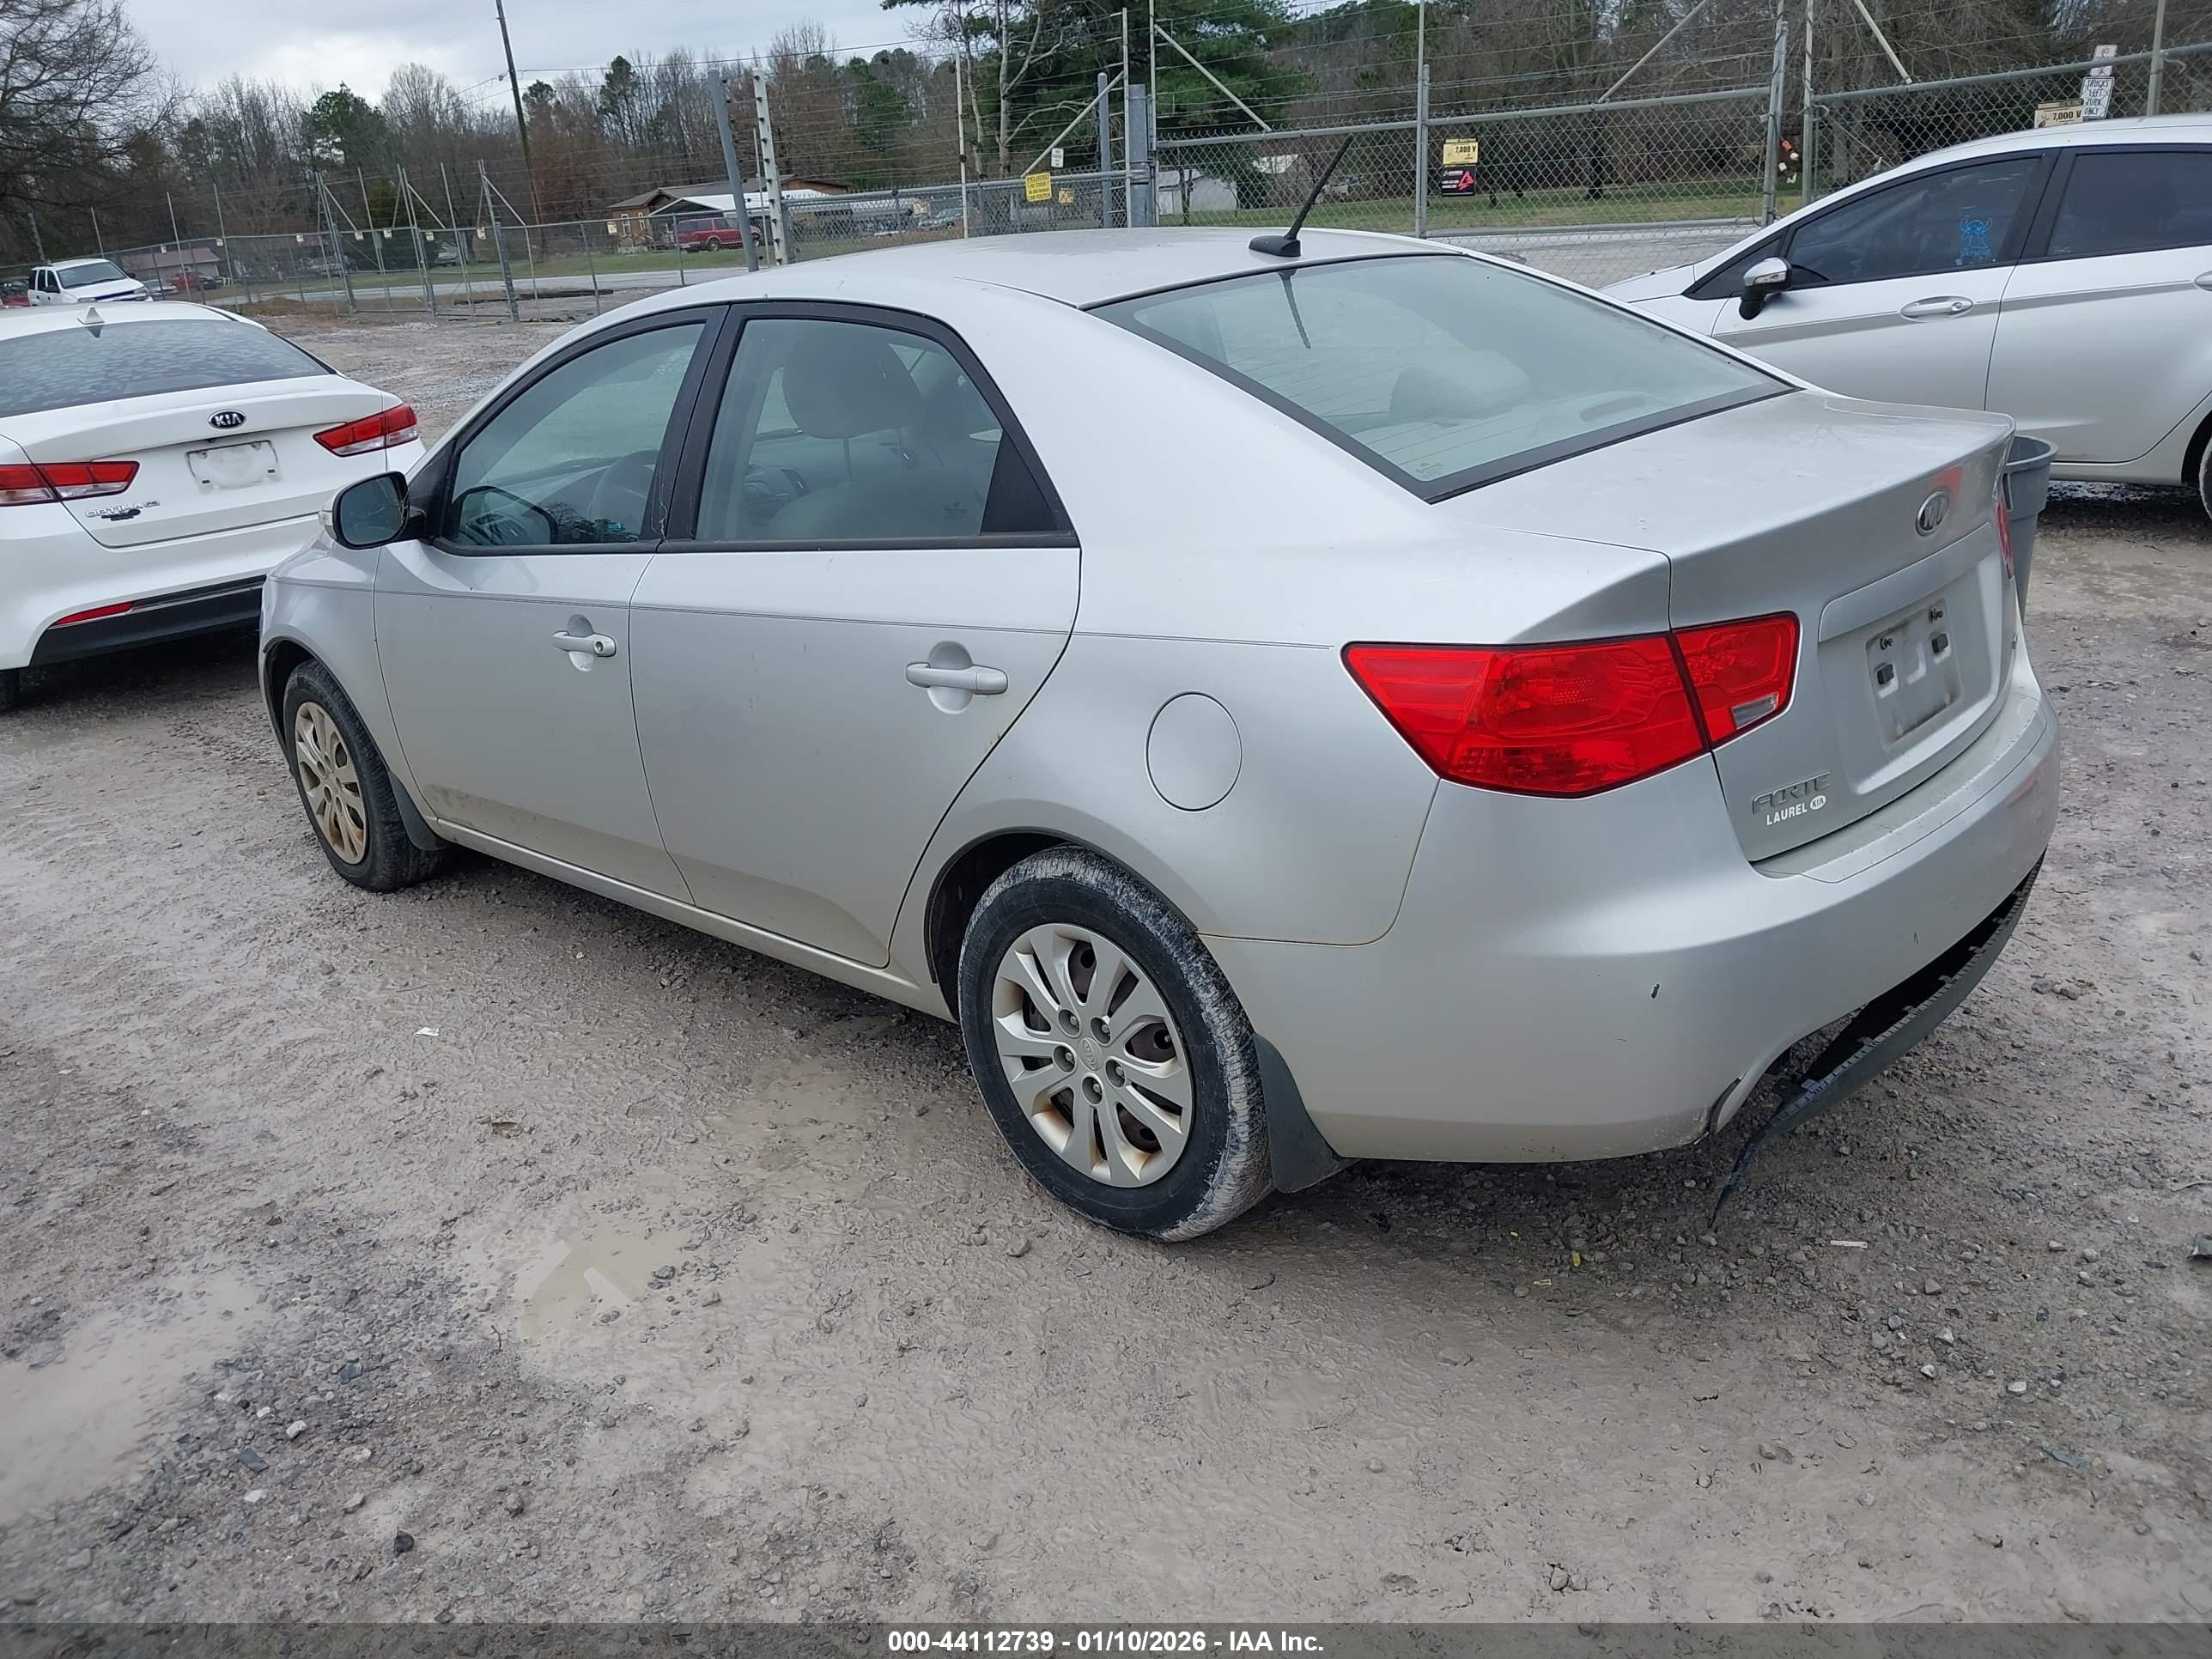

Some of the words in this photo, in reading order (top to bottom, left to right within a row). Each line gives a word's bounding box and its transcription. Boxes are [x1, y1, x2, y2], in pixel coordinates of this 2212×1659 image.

[2052, 111, 2074, 121] 7,000
[2075, 110, 2082, 118] V
[1455, 145, 1471, 155] 7,000
[214, 412, 243, 428] KIA
[1765, 801, 1808, 826] LAUREL
[1810, 796, 1826, 810] KIA
